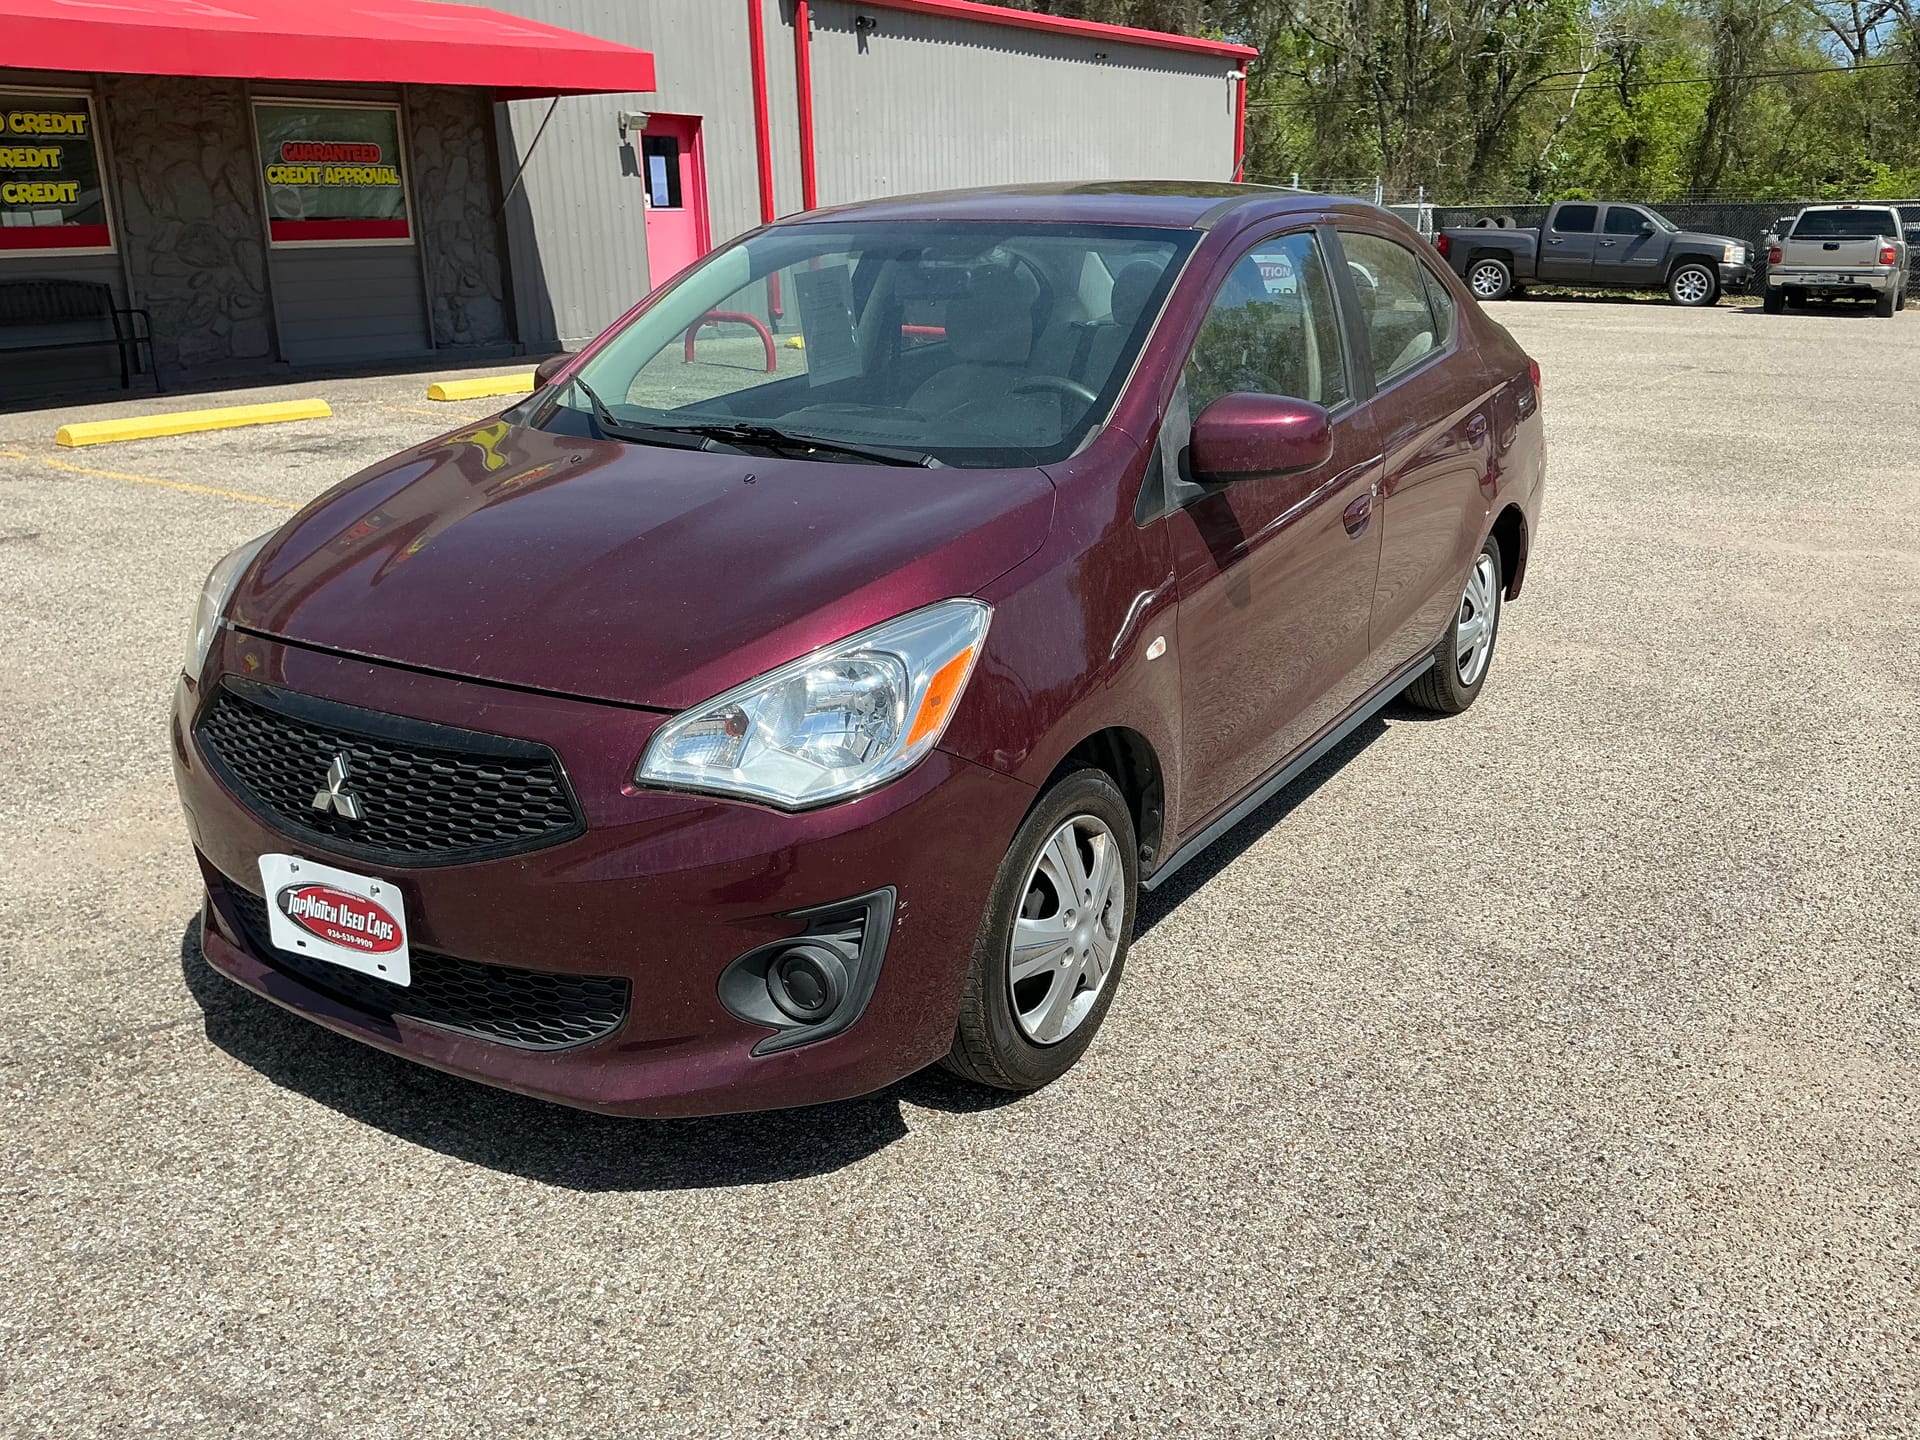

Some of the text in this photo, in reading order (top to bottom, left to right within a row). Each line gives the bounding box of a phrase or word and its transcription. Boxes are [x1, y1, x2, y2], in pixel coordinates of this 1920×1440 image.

[8, 112, 87, 134] CREDIT
[282, 142, 380, 163] GUARANTEED
[267, 166, 399, 185] CREDIT APPROVAL
[2, 183, 78, 204] CREDIT
[338, 903, 365, 931] USED
[367, 912, 394, 940] CARS
